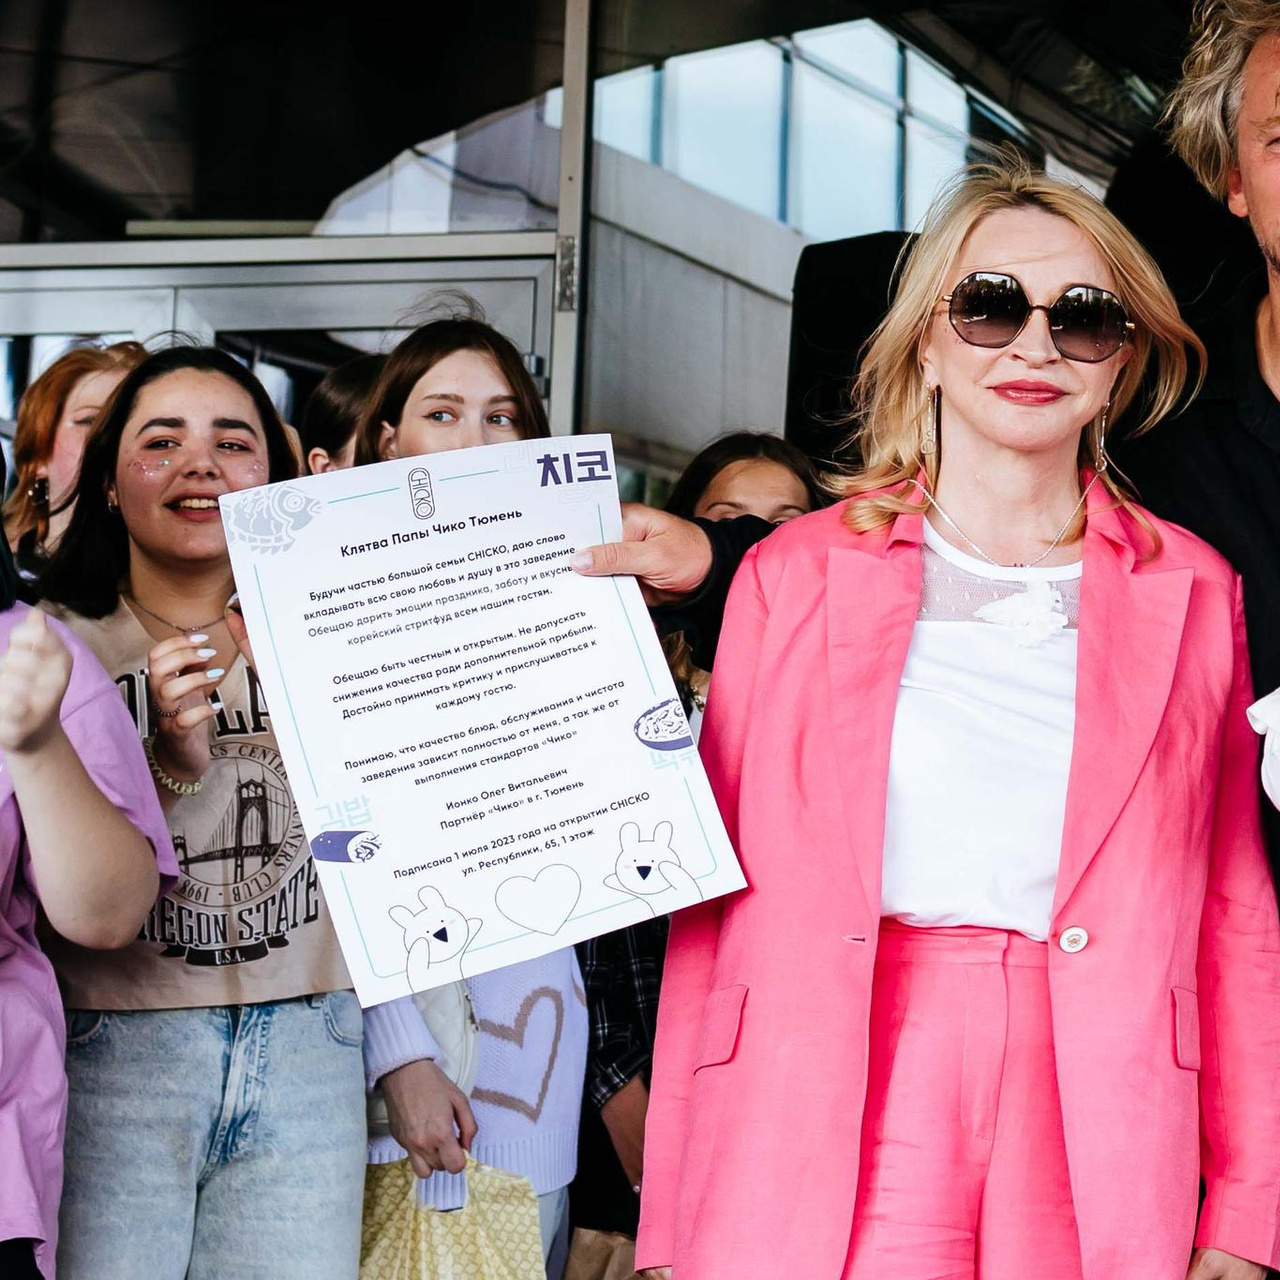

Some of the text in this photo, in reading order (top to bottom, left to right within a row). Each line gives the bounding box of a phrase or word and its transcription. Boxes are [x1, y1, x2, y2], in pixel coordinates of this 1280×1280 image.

[410, 470, 433, 518] CHICKO
[537, 450, 612, 487] 치코
[339, 509, 524, 558] Клятва Папы Чико Тюмень
[303, 546, 576, 622] вкладывать всю свою любовь и душу в это заведение
[308, 533, 567, 603] Будучи частью большой семьи CHICKO, даю слово
[307, 620, 355, 638] Обещаю
[356, 611, 394, 627] дарить
[394, 600, 434, 616] эмоции
[434, 585, 493, 607] праздника,
[494, 575, 529, 591] заботу
[530, 573, 538, 581] и
[347, 588, 553, 646] корейский стритфуд всем нашим гостям.
[332, 610, 587, 686] Обещаю быть честным и открытым. Не допускать
[332, 624, 597, 704] снижения качества ради дополнительной прибыли.
[341, 639, 598, 721] Достойно принимать критику и прислушиваться к
[434, 682, 517, 711] каждому гостю.
[343, 680, 626, 771] Понимаю, что качество блюд, обслуживания и чистота
[360, 698, 620, 784] заведения зависит полностью от меня, а так же от
[413, 761, 478, 786] выполнения
[479, 742, 540, 767] стандартов
[445, 768, 568, 811] Ионко Олег Витальевич
[439, 810, 486, 831] Партнёр
[526, 796, 534, 804] в
[534, 793, 543, 802] г.
[542, 781, 585, 798] Тюмень
[392, 791, 651, 880] Подписана 1 июля 2023 года на открытии CHICKO
[461, 828, 595, 878] ул. Республики, 65, 1 этаж
[137, 855, 319, 947] REGON STATE
[179, 879, 209, 904] 1998
[233, 873, 272, 904] CLUB
[214, 949, 246, 966] U.S.A.
